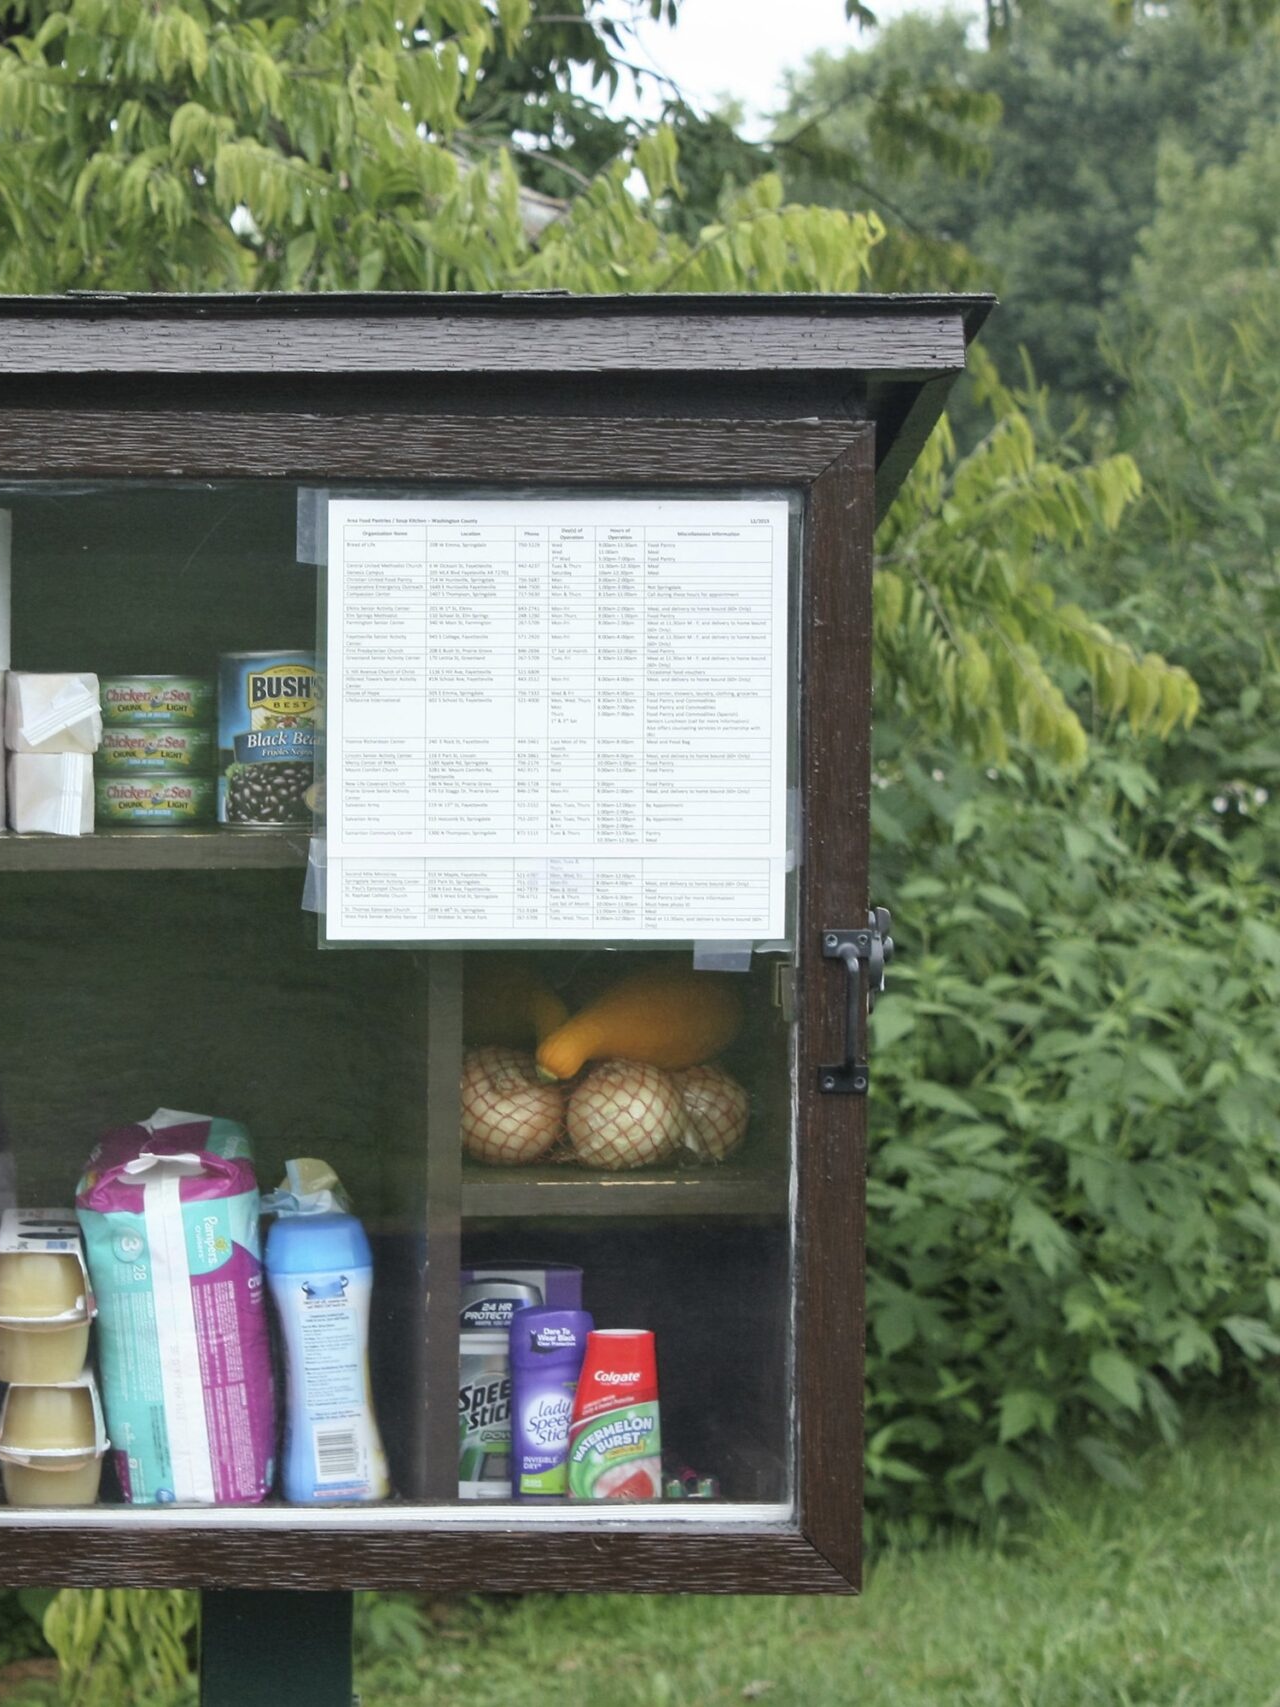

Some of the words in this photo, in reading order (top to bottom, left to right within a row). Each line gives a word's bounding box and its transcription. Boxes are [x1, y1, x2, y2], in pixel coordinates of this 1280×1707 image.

[106, 688, 152, 703] Chicken
[170, 689, 192, 701] Sea
[166, 704, 188, 712] LIGHT
[102, 735, 146, 749] Chicken
[164, 735, 186, 748] Sea
[247, 731, 287, 748] Black
[161, 751, 183, 759] LIGHT
[107, 786, 152, 800] Chicken
[170, 787, 192, 798] Sea
[167, 801, 188, 809] LIGHT
[121, 1237, 140, 1251] 3
[203, 1216, 218, 1264] Pampers
[133, 1264, 147, 1281] 28
[481, 1303, 497, 1311] 24
[498, 1303, 513, 1311] HR
[464, 1312, 513, 1320] PROTECTI
[537, 1334, 557, 1342] Wear
[557, 1333, 577, 1342] Black
[594, 1370, 641, 1385] Colgate
[539, 1399, 572, 1419] lady
[573, 1417, 653, 1462] WATERMELON
[595, 1432, 642, 1454] BURST
